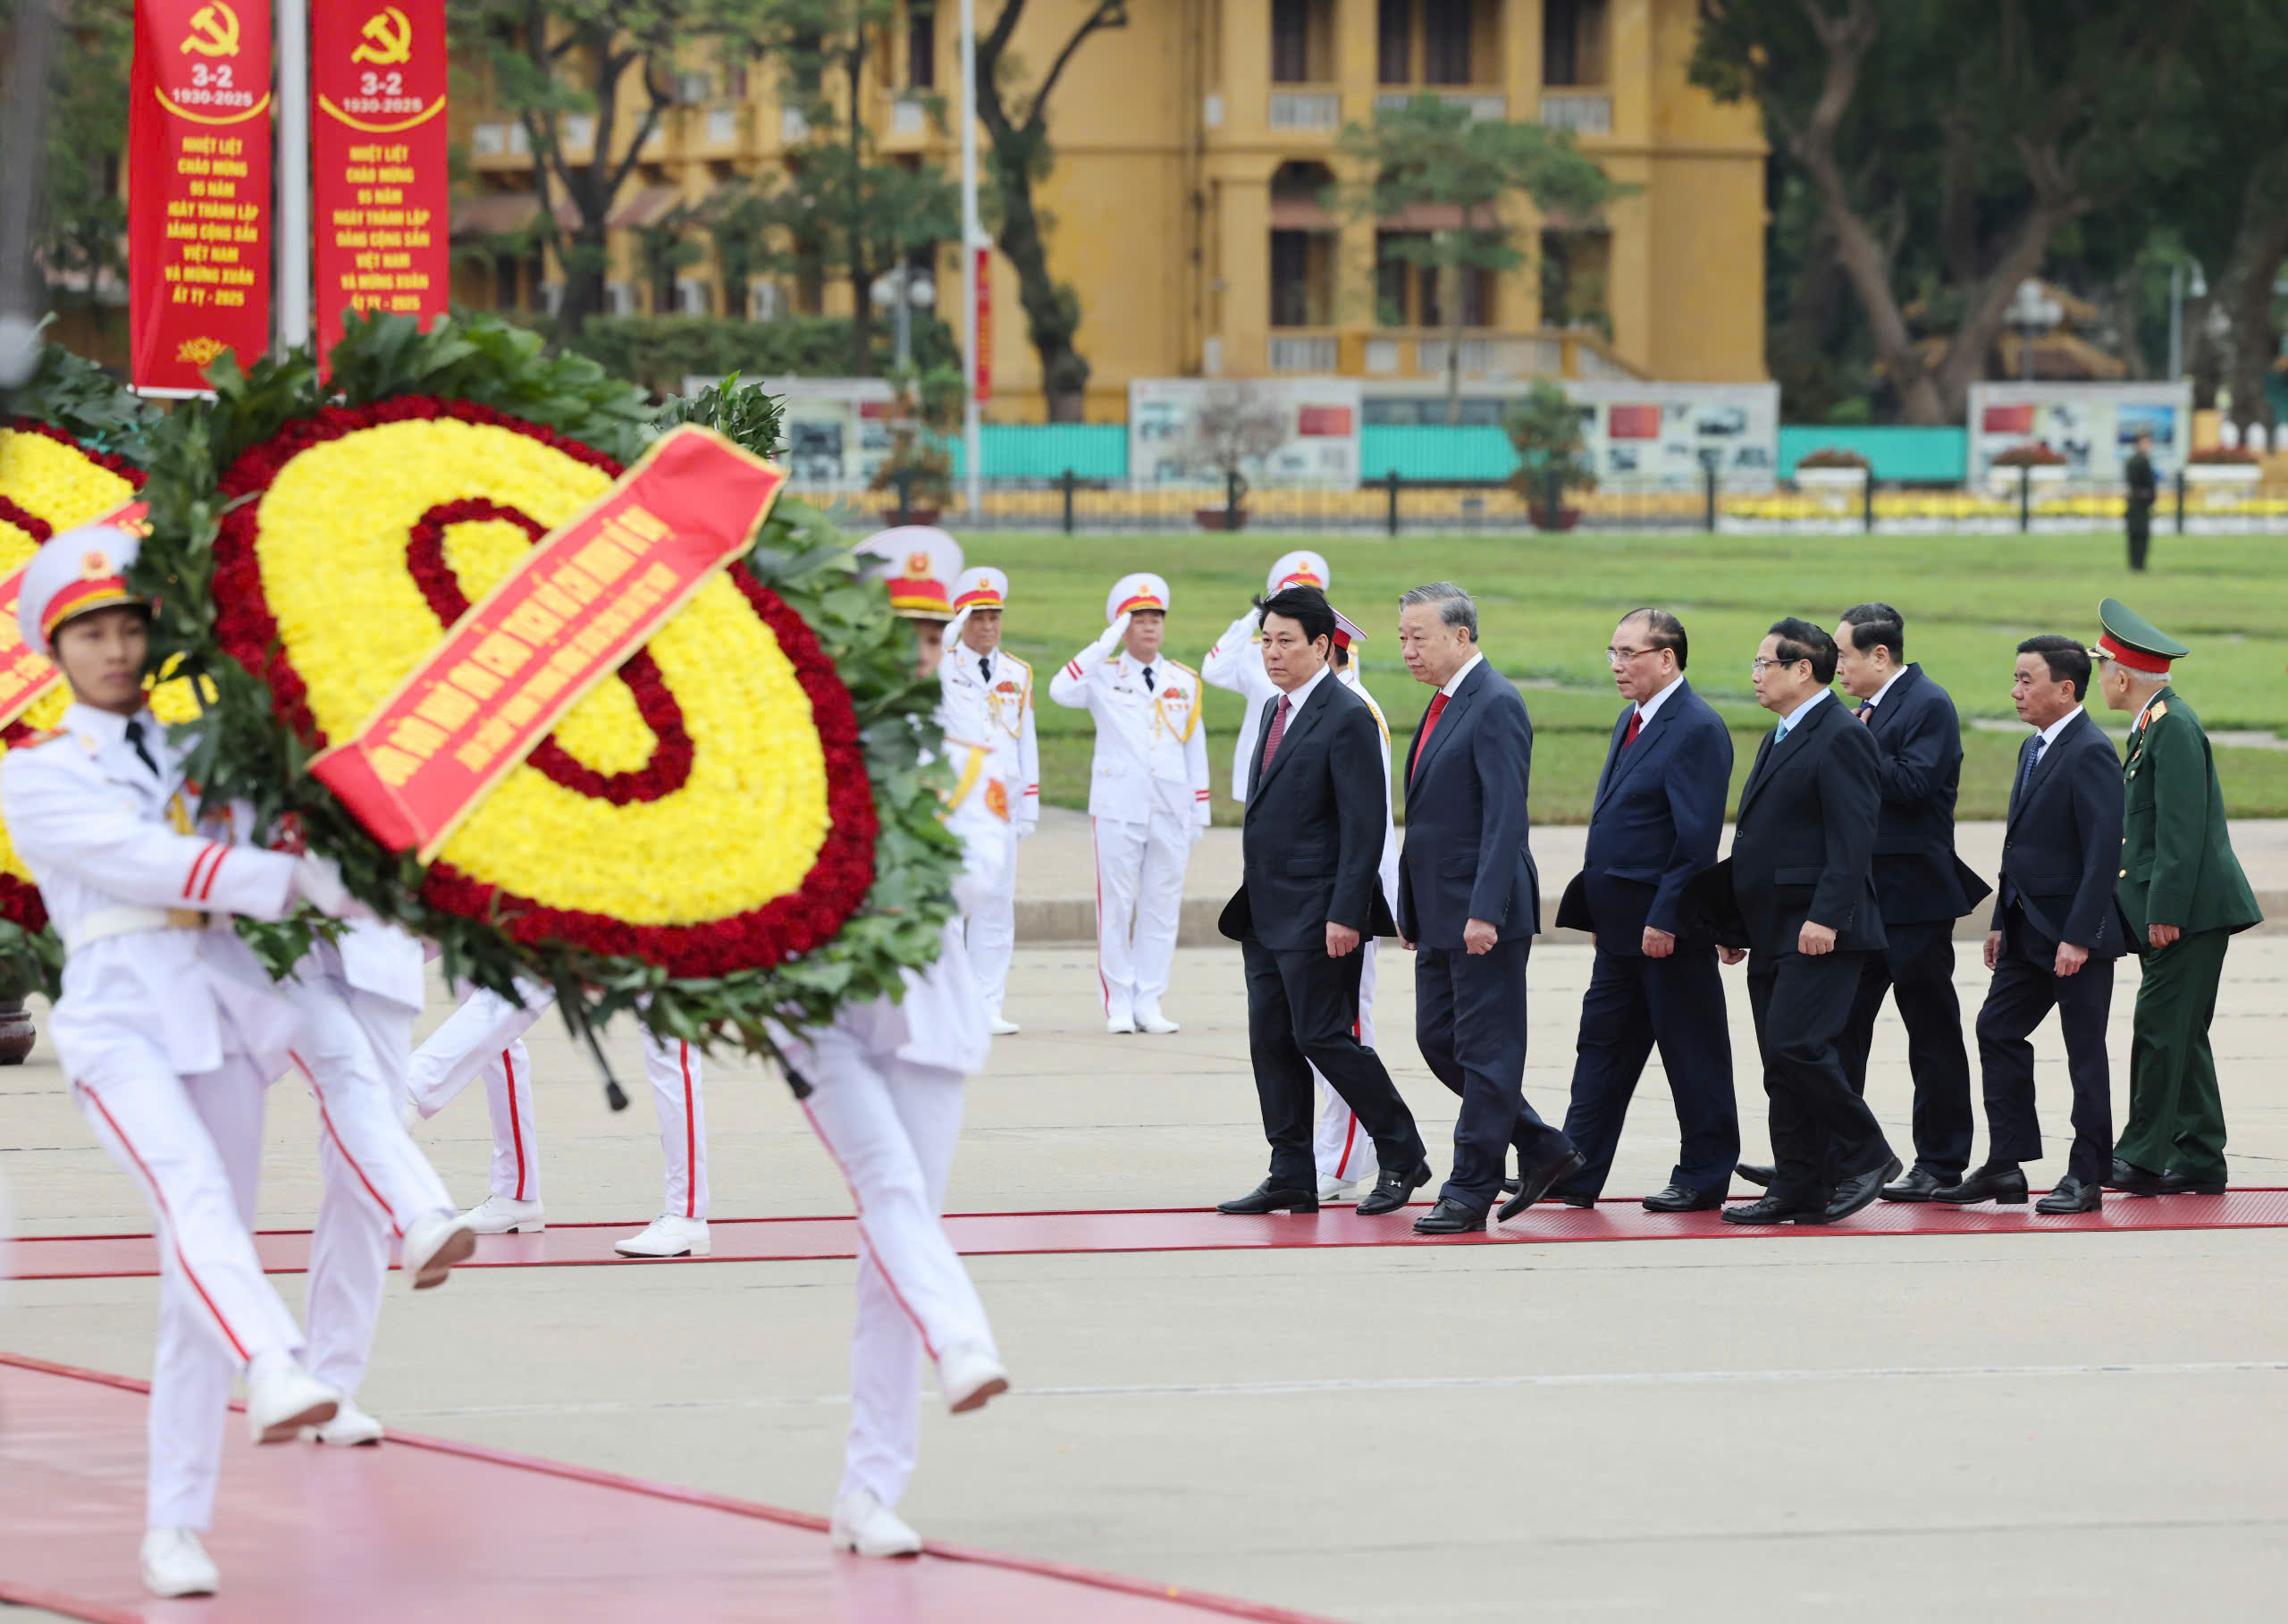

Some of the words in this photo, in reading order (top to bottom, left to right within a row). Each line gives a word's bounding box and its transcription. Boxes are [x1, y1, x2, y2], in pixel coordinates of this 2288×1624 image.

[192, 63, 232, 88] 3-2
[361, 72, 402, 96] 3-2
[172, 88, 253, 107] 1930-2025
[343, 97, 423, 114] 1930-2025
